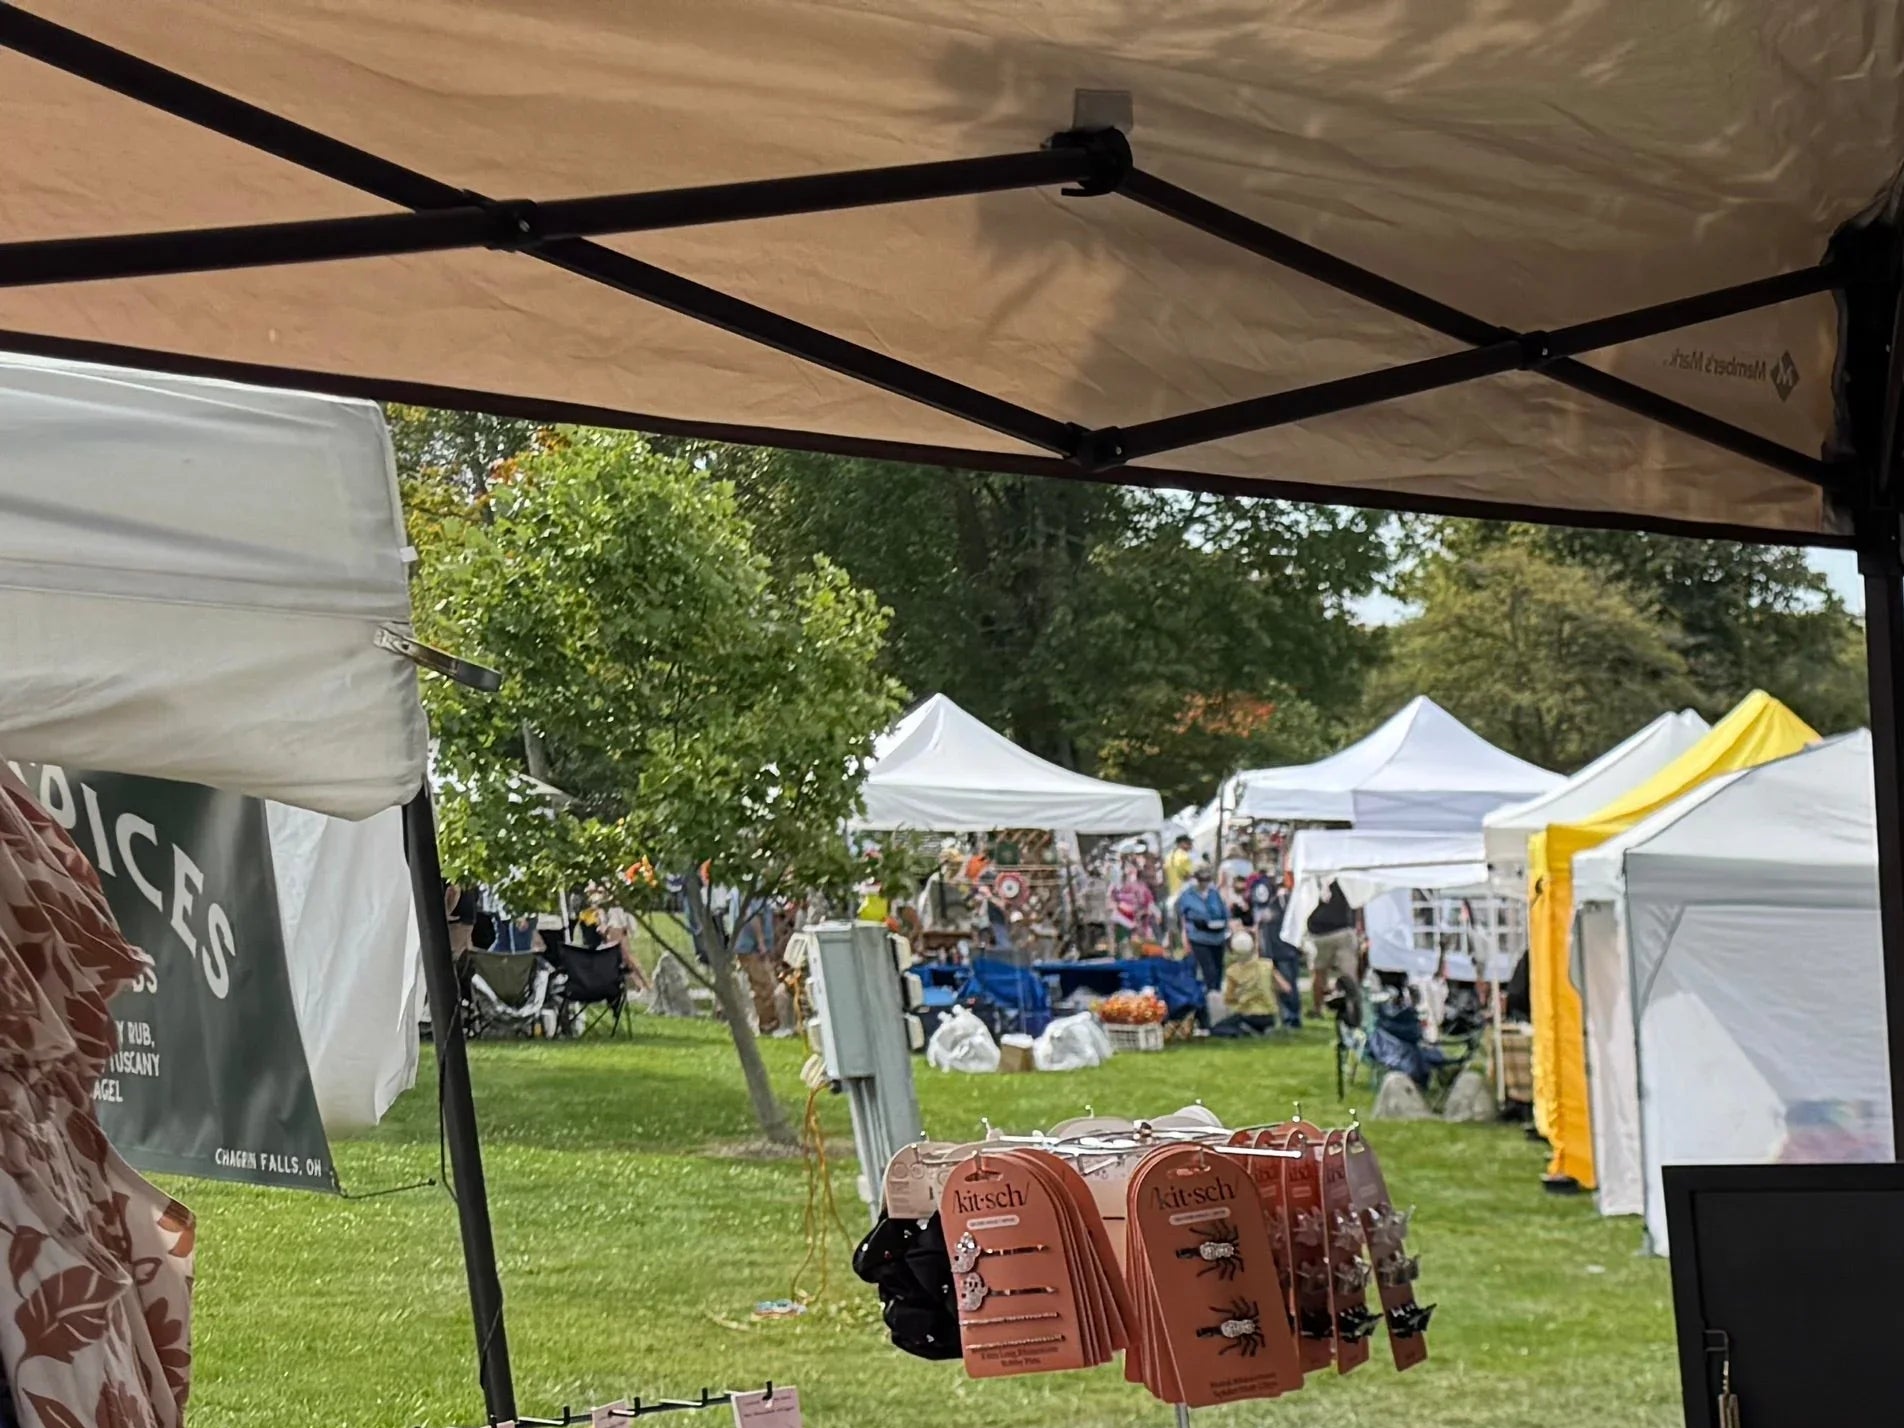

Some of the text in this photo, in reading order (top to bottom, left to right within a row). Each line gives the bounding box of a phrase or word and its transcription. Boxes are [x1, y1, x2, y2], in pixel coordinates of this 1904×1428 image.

[8, 761, 236, 999] PICES
[93, 1079, 124, 1102] AGEL
[305, 1158, 323, 1178] OH
